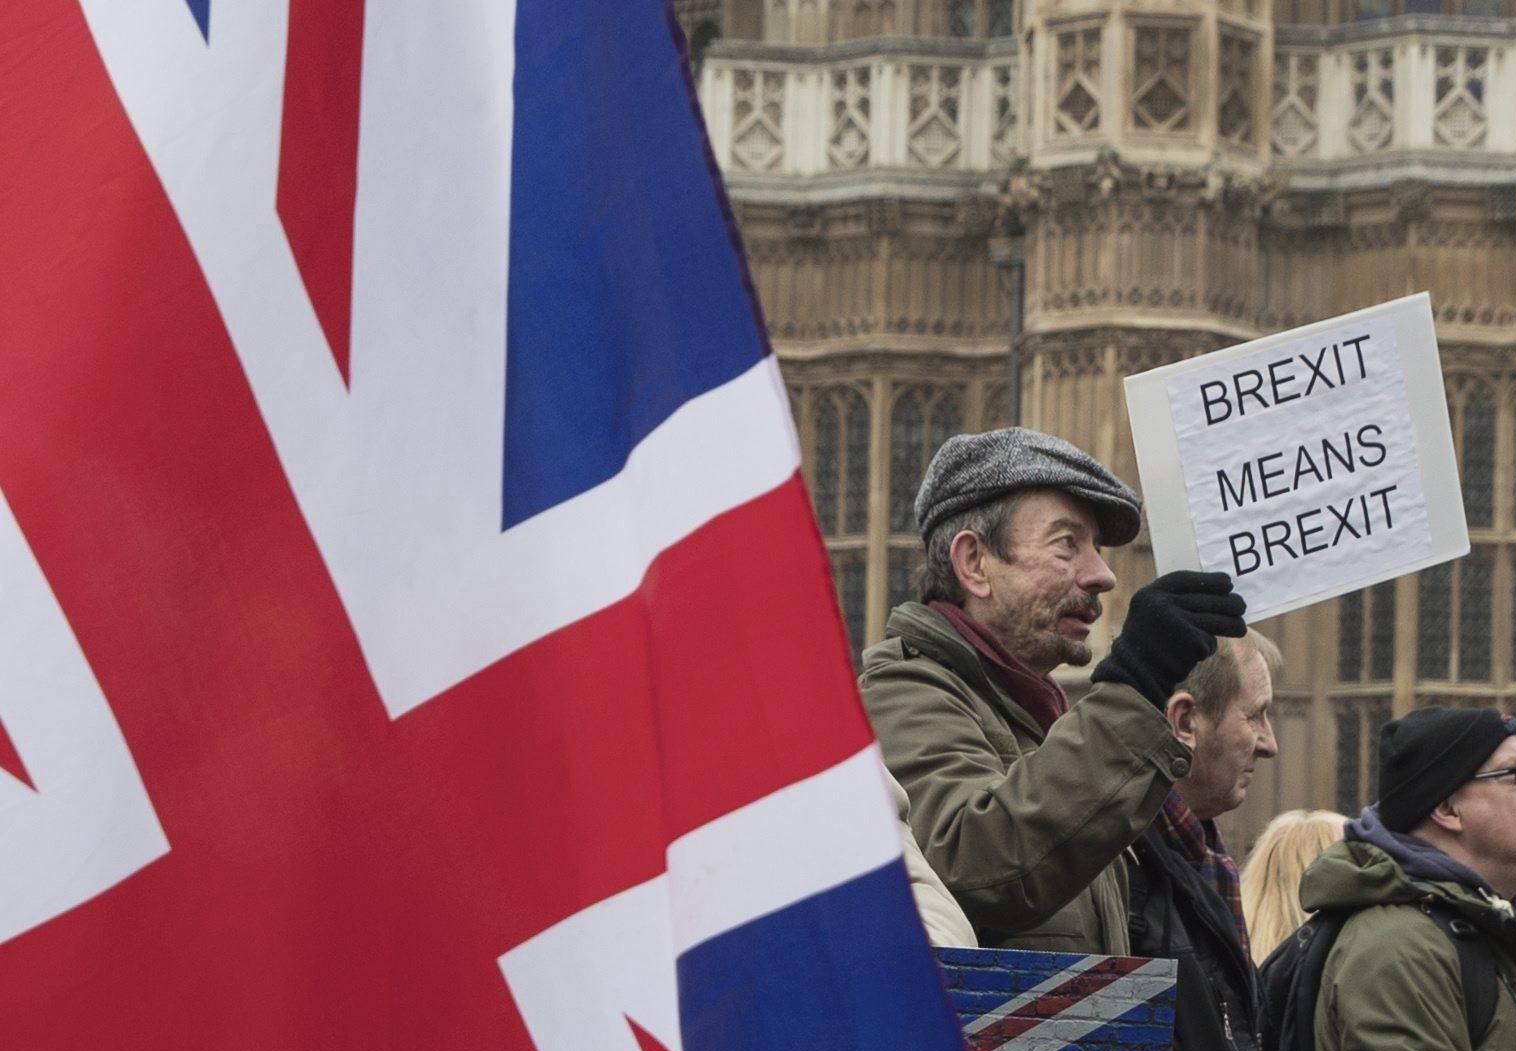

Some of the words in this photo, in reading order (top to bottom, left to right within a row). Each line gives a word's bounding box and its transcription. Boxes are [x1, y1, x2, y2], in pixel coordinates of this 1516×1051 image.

[1200, 334, 1370, 425] BREXIT
[1216, 424, 1387, 511] MEANS
[1229, 484, 1397, 577] BREXIT
